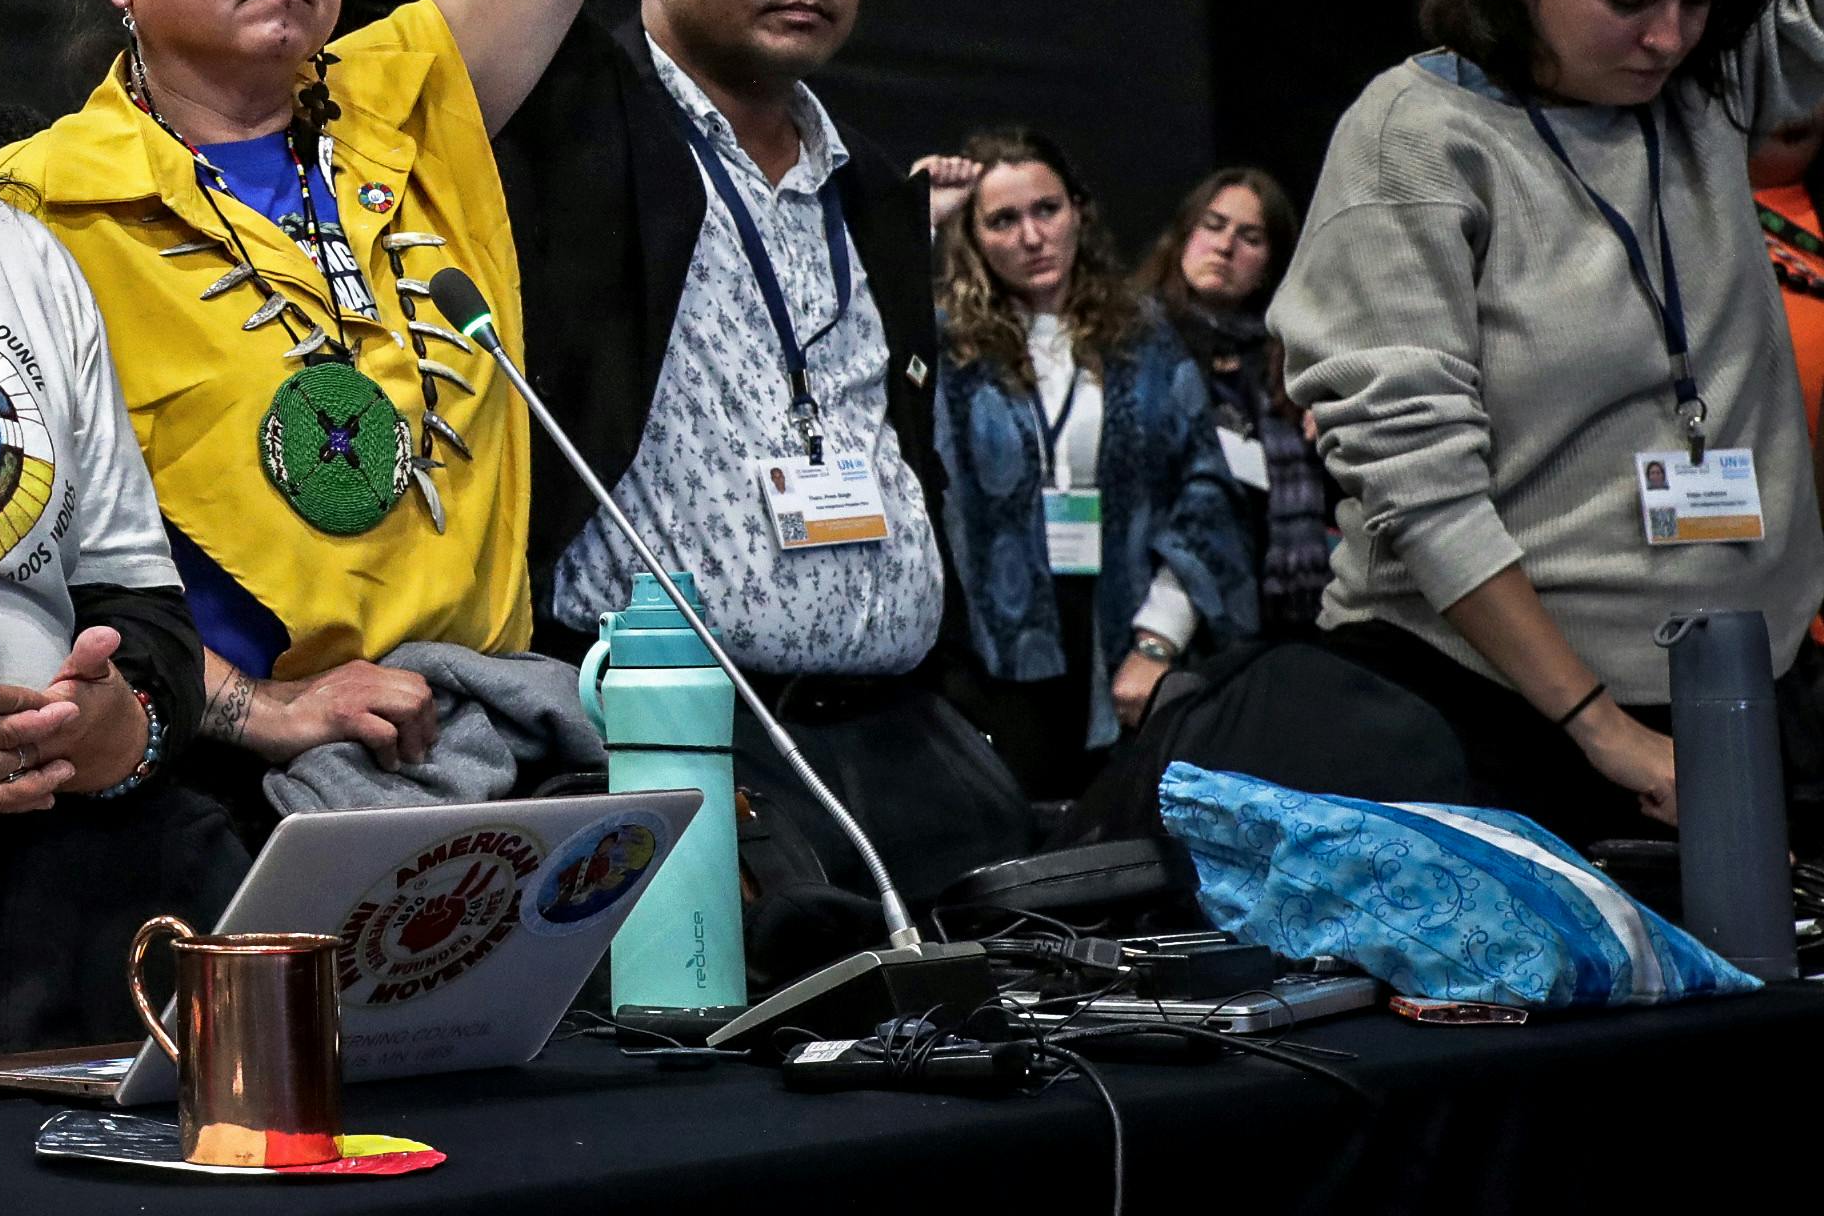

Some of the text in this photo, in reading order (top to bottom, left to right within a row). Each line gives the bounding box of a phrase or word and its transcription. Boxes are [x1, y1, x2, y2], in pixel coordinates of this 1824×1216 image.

[396, 831, 540, 890] AMERICAN
[387, 887, 506, 976] WOUNDED KNEE
[393, 895, 426, 929] 1890
[687, 910, 707, 989] reduce
[412, 1022, 492, 1044] COUNCIL
